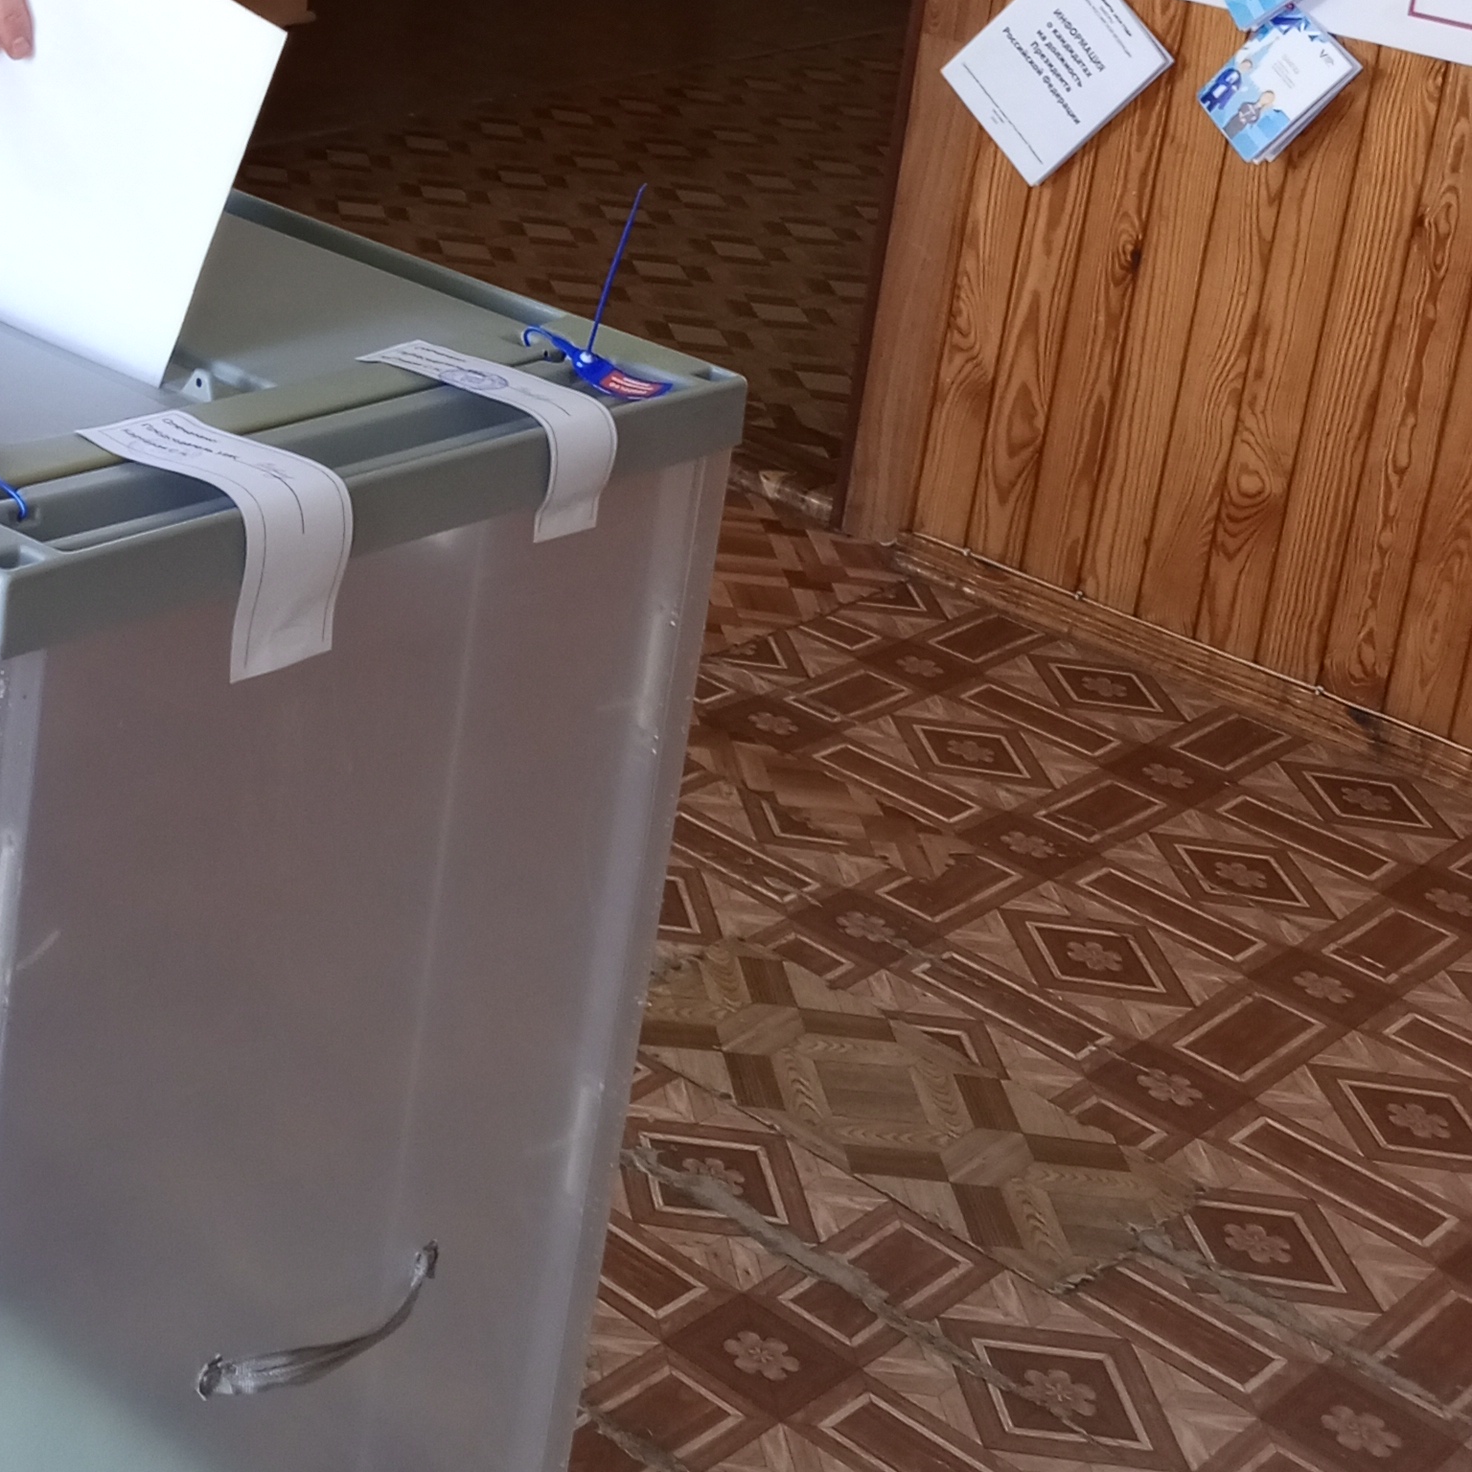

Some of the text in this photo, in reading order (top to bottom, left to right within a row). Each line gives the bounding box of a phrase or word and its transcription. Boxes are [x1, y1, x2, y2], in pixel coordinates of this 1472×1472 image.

[1029, 39, 1073, 93] Президента
[1036, 28, 1083, 89] на должность
[1051, 28, 1093, 79] кандидатах
[1052, 7, 1107, 73] ИНФОРМАЦИЯ
[1002, 25, 1081, 126] Российской Федерации
